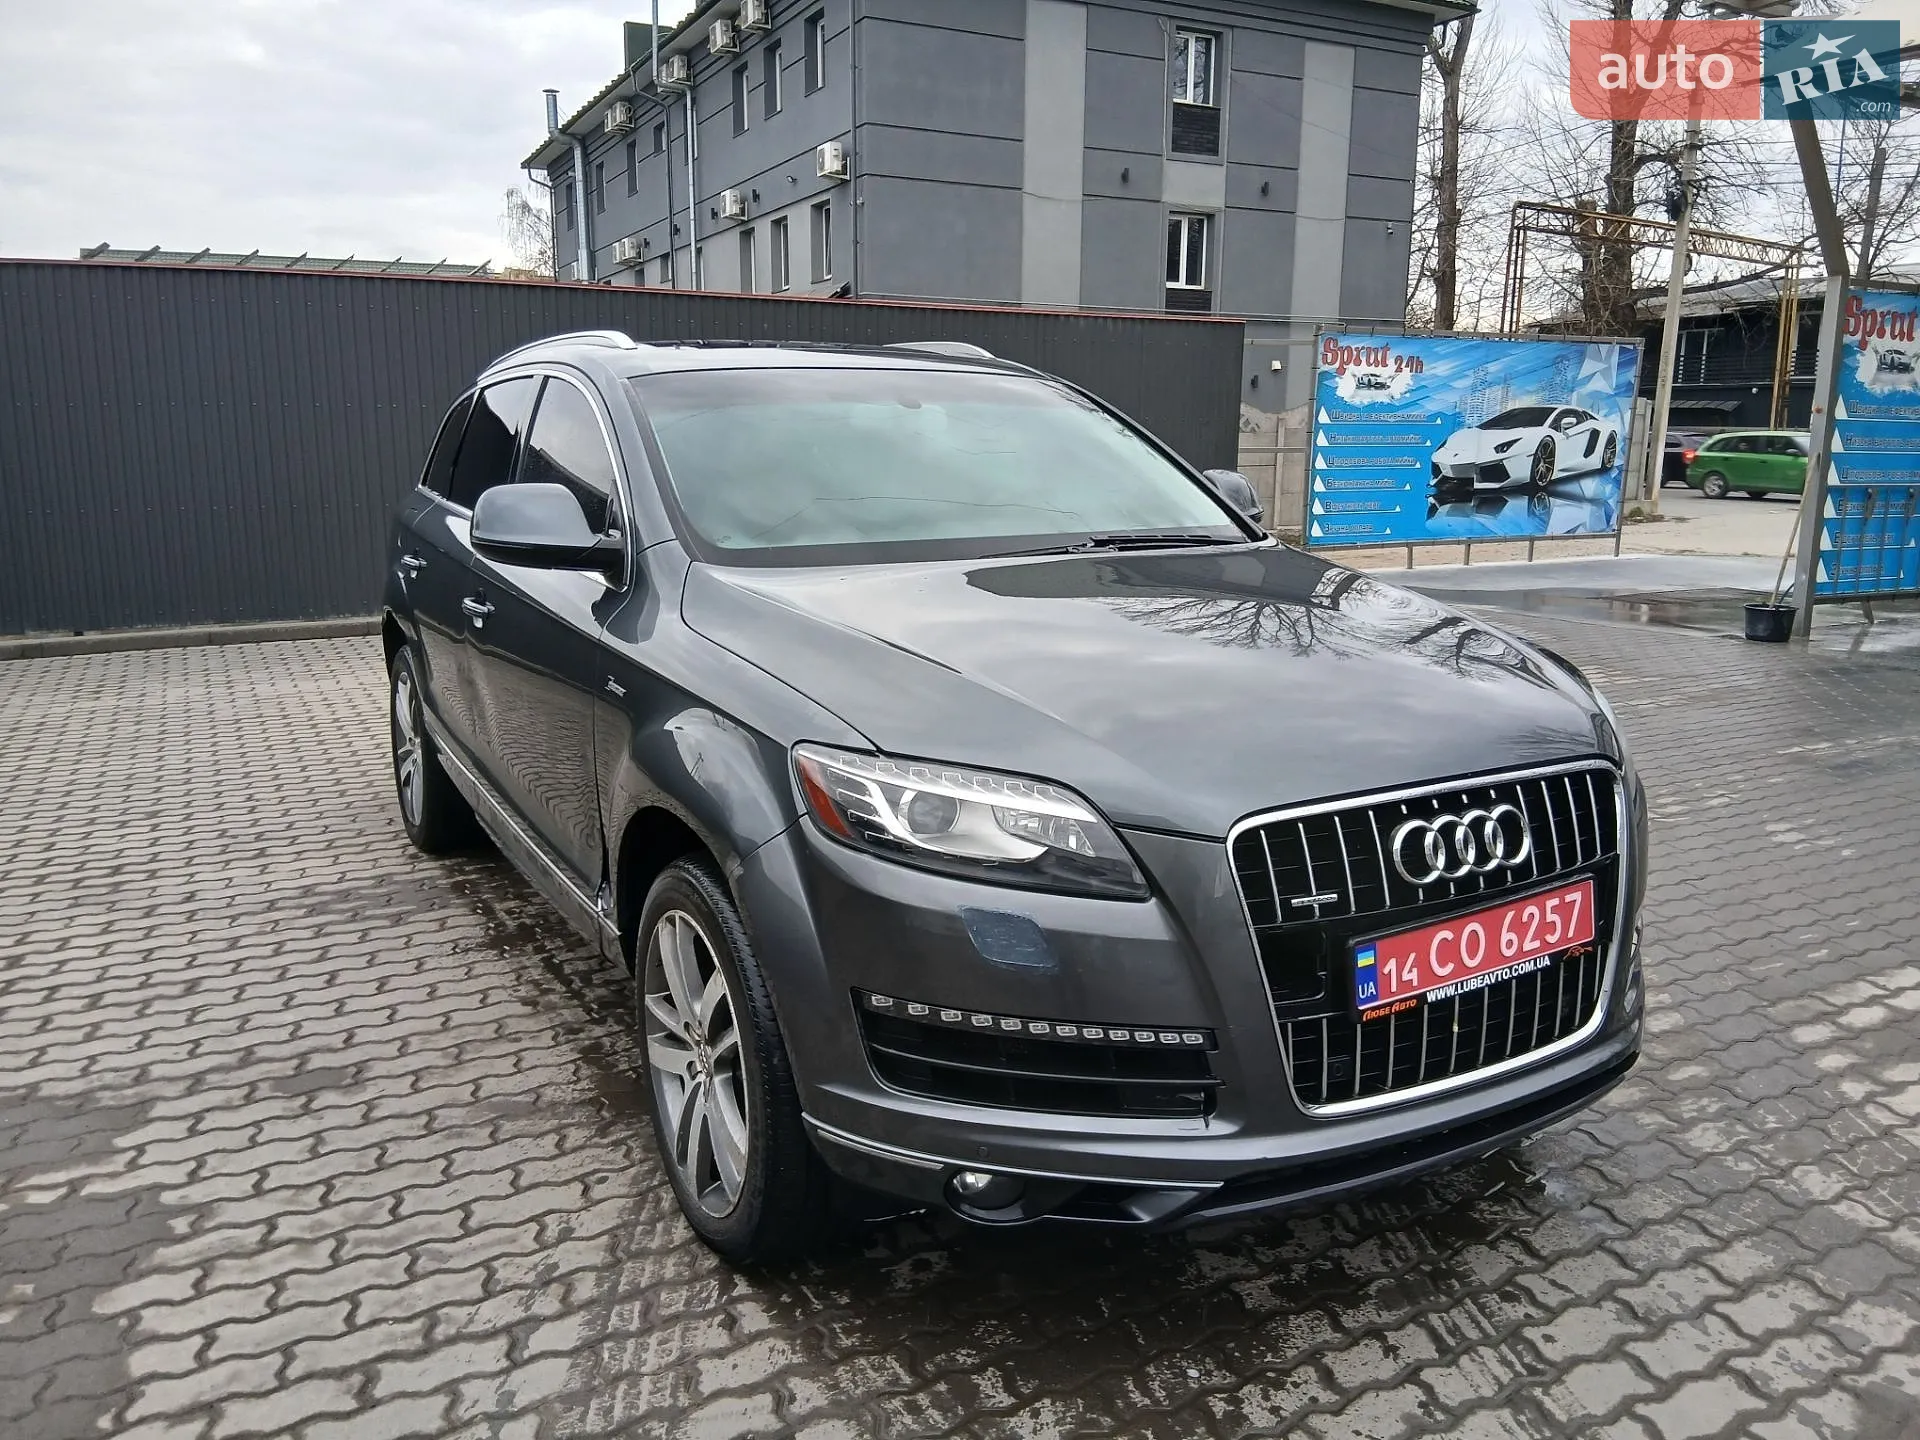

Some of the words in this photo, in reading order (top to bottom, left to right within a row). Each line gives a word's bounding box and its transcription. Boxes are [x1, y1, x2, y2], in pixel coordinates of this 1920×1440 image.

[1841, 290, 1918, 351] Sprut
[1321, 337, 1390, 376] Sprut
[1383, 952, 1418, 993] 14
[1429, 921, 1486, 977] CO
[1500, 891, 1582, 958] 6257
[1358, 982, 1377, 999] UA
[1426, 955, 1551, 1002] WWW.LUBEAVTO.COM.UA
